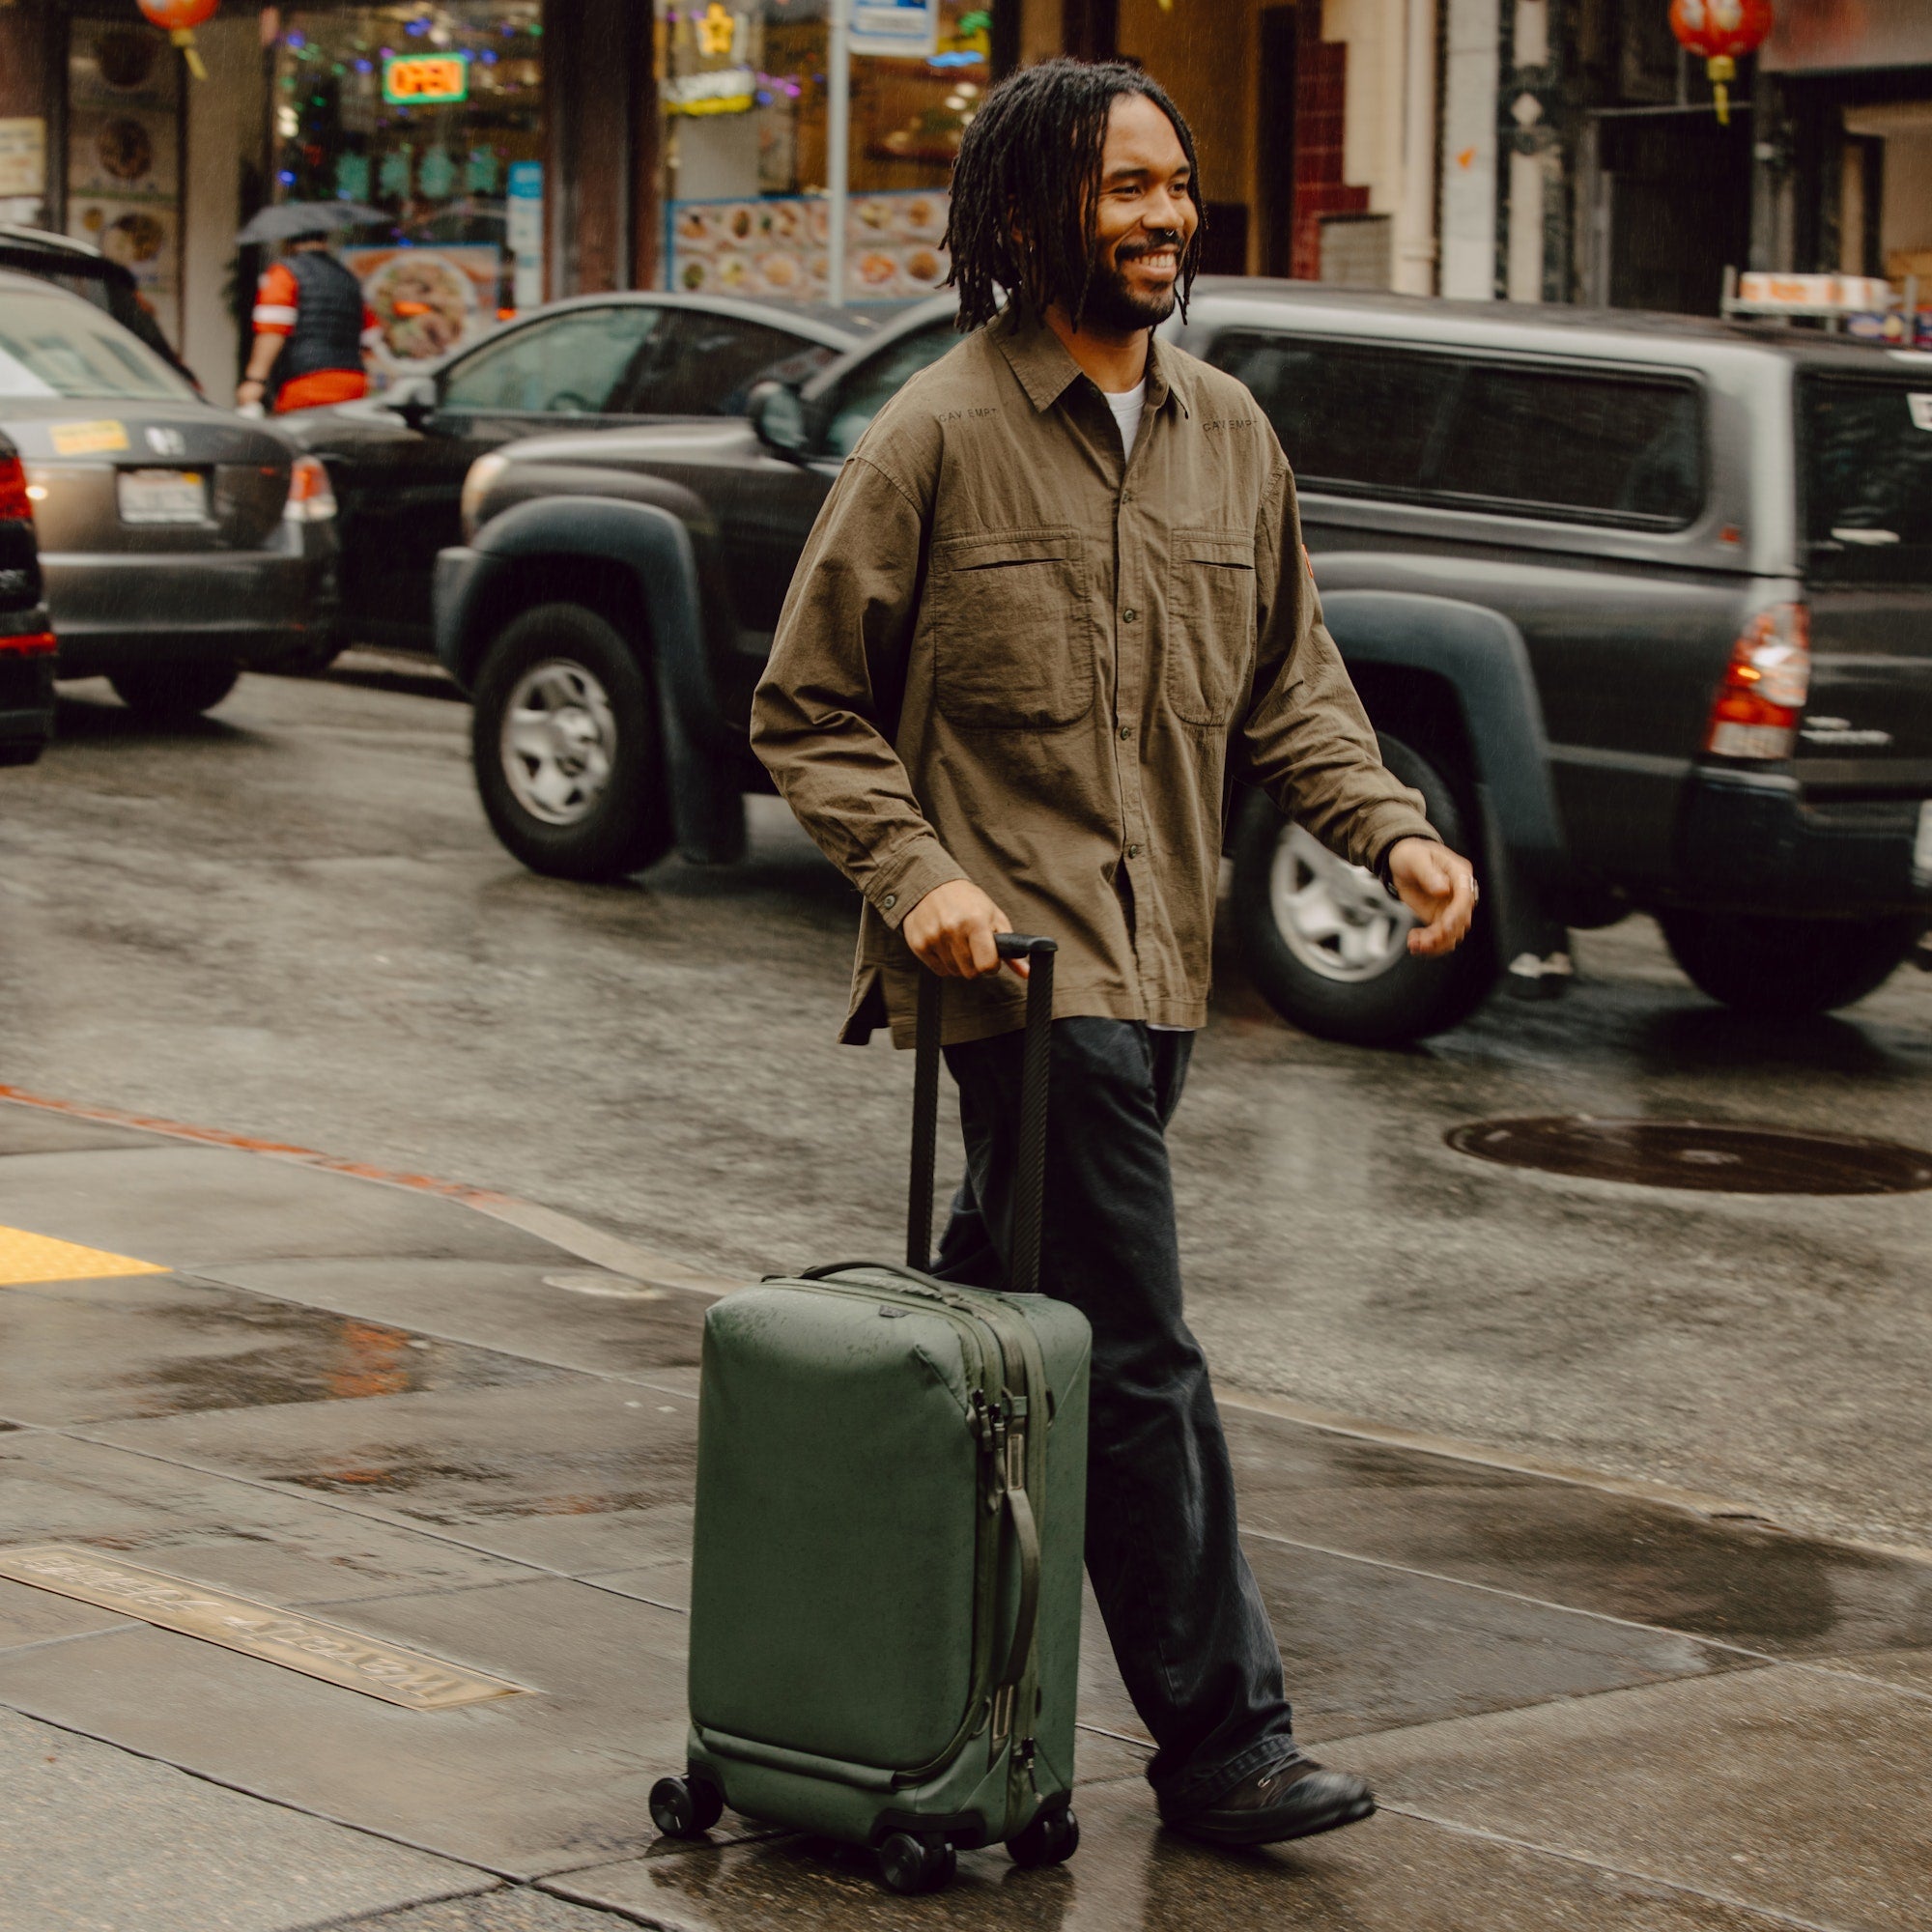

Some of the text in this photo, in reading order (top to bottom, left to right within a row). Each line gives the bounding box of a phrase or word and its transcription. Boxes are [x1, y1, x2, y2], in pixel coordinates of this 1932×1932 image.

[938, 408, 997, 423] CAV EMPT
[221, 1618, 467, 1701] Waverly
